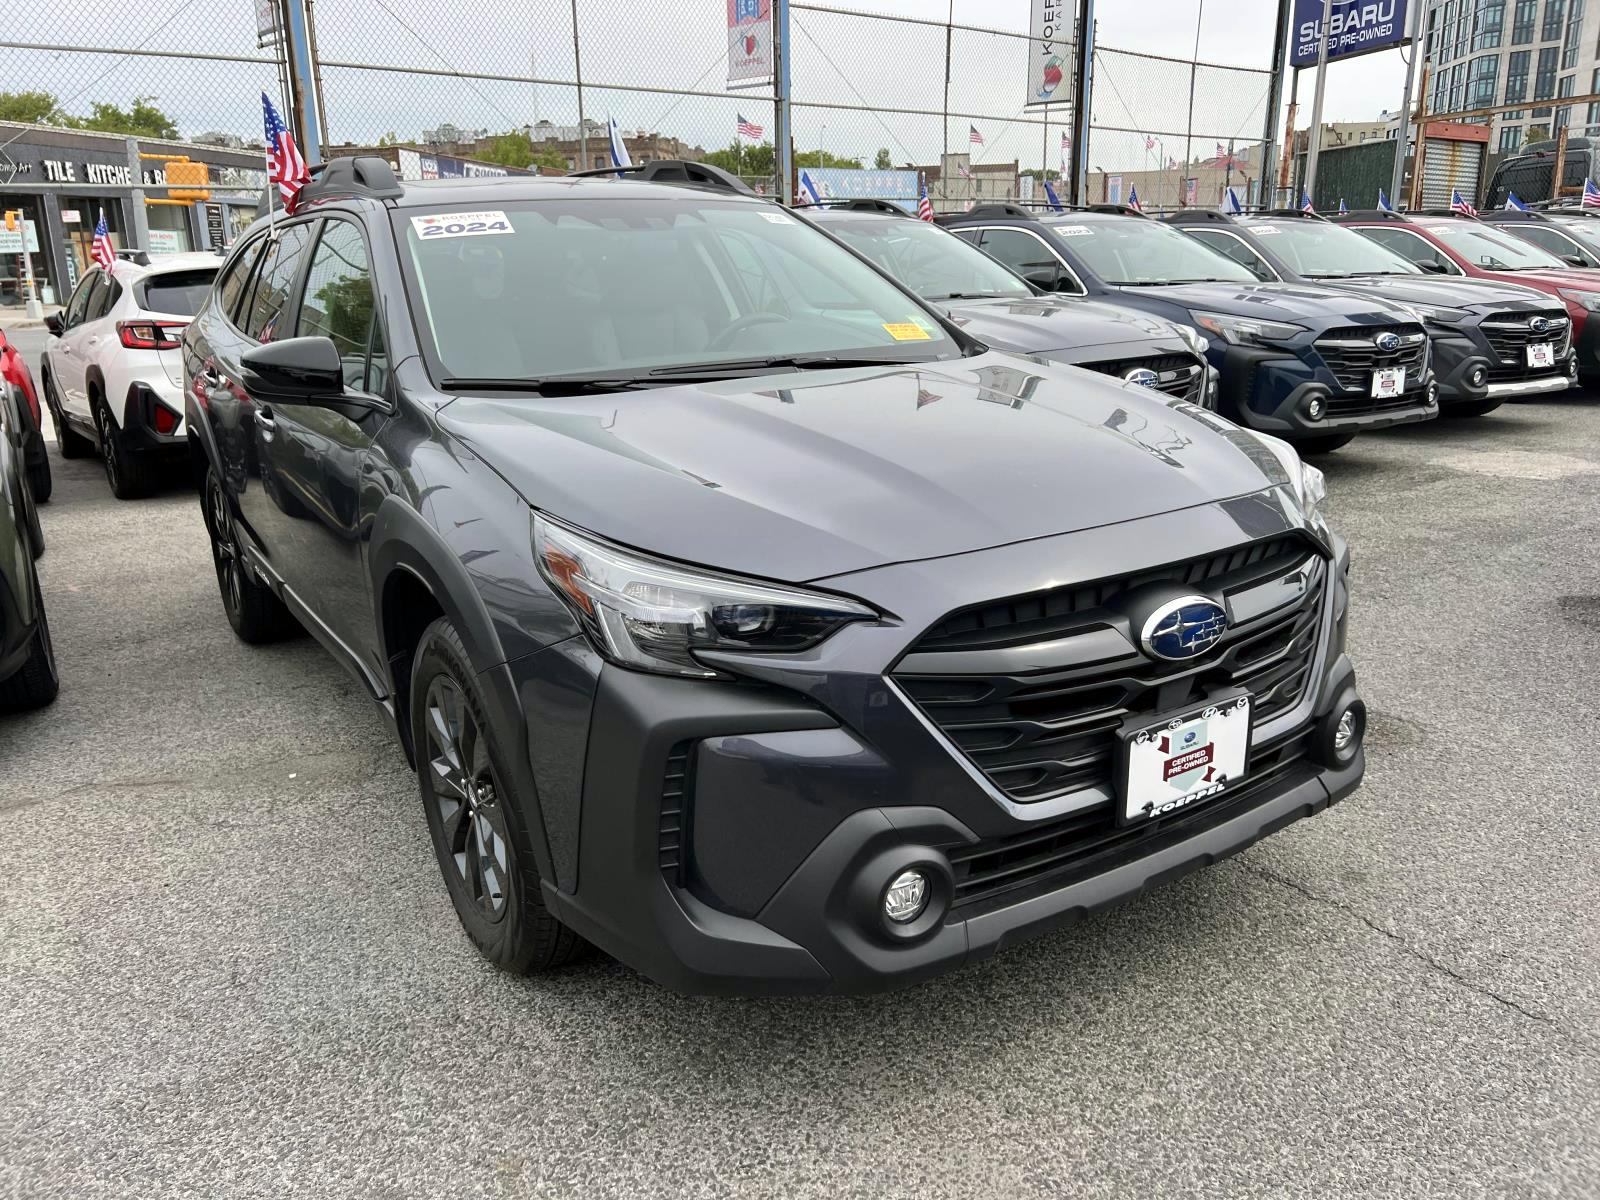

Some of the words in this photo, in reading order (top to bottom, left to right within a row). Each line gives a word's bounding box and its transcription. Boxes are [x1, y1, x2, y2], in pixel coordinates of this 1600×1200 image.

[1300, 0, 1396, 43] SUBARU
[1298, 37, 1338, 56] CERTED
[1340, 23, 1393, 47] PRE-OWNED
[44, 159, 76, 182] TILE
[86, 163, 132, 185] KITCHE
[143, 170, 151, 185] &
[442, 212, 501, 221] KOEPPEL
[422, 221, 509, 236] 2024
[1168, 755, 1209, 775] PRE-OWNED
[1172, 749, 1206, 767] CERTIFIED
[1149, 783, 1226, 818] KOEPPEL
